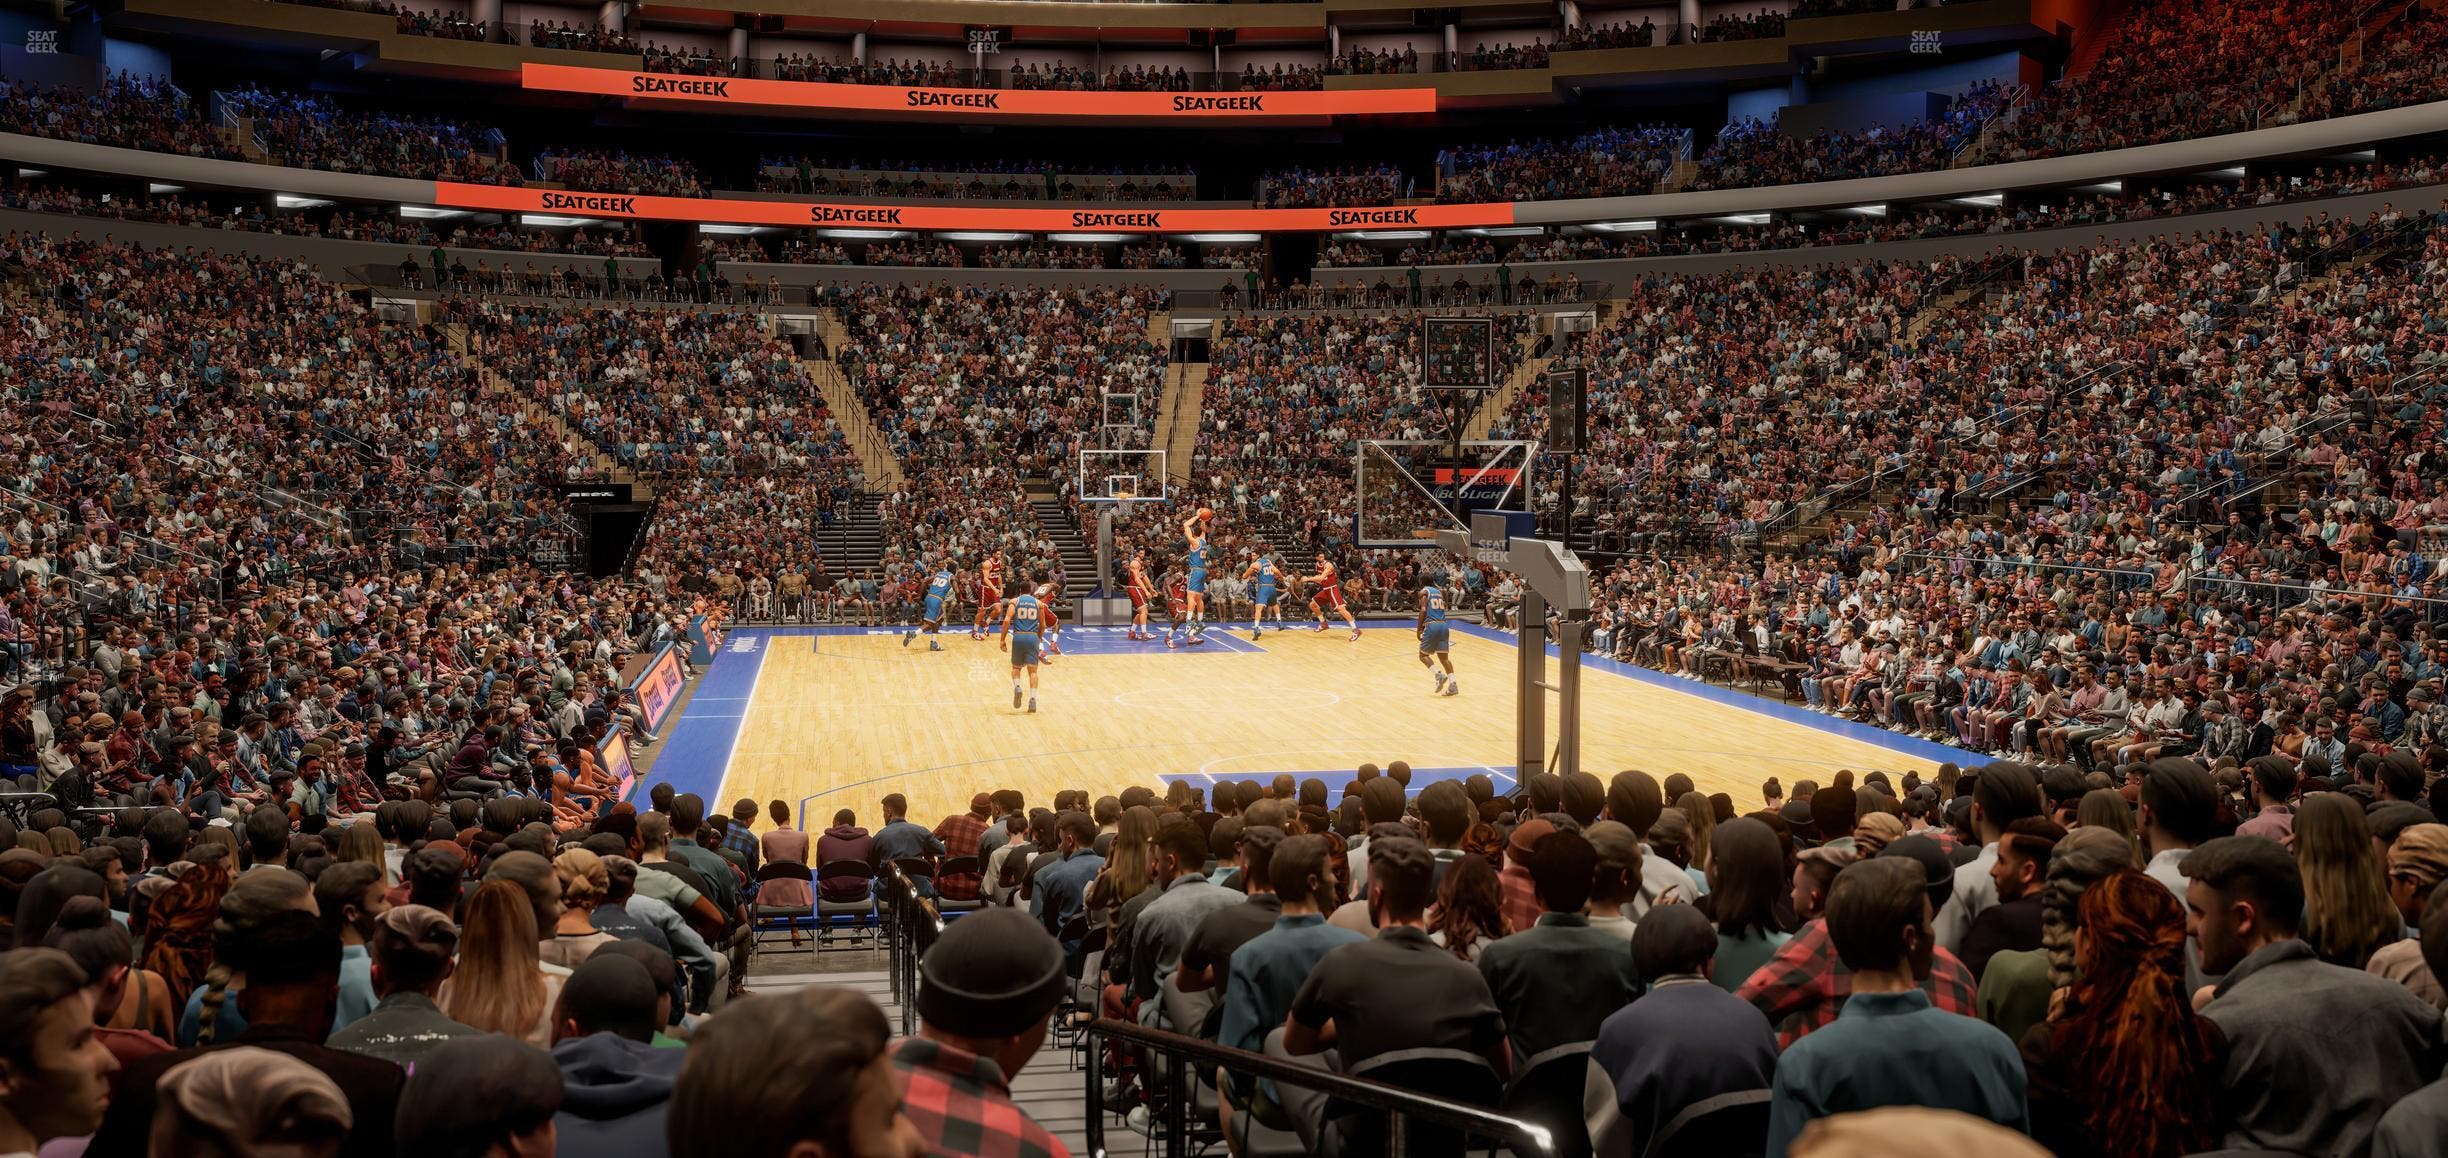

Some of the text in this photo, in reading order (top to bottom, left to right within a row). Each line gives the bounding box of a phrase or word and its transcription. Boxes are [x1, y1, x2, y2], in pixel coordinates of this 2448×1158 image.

[632, 76, 729, 98] SEATGEEK
[907, 90, 1000, 110] SEATGEEK
[1173, 95, 1264, 112] SEATGEEK
[542, 192, 636, 214] SEATGEEK
[811, 206, 902, 224] SEATGEEK
[1072, 212, 1161, 228] SEATGEEK
[1329, 208, 1418, 226] SEATGEEK
[1017, 607, 1038, 620] 00
